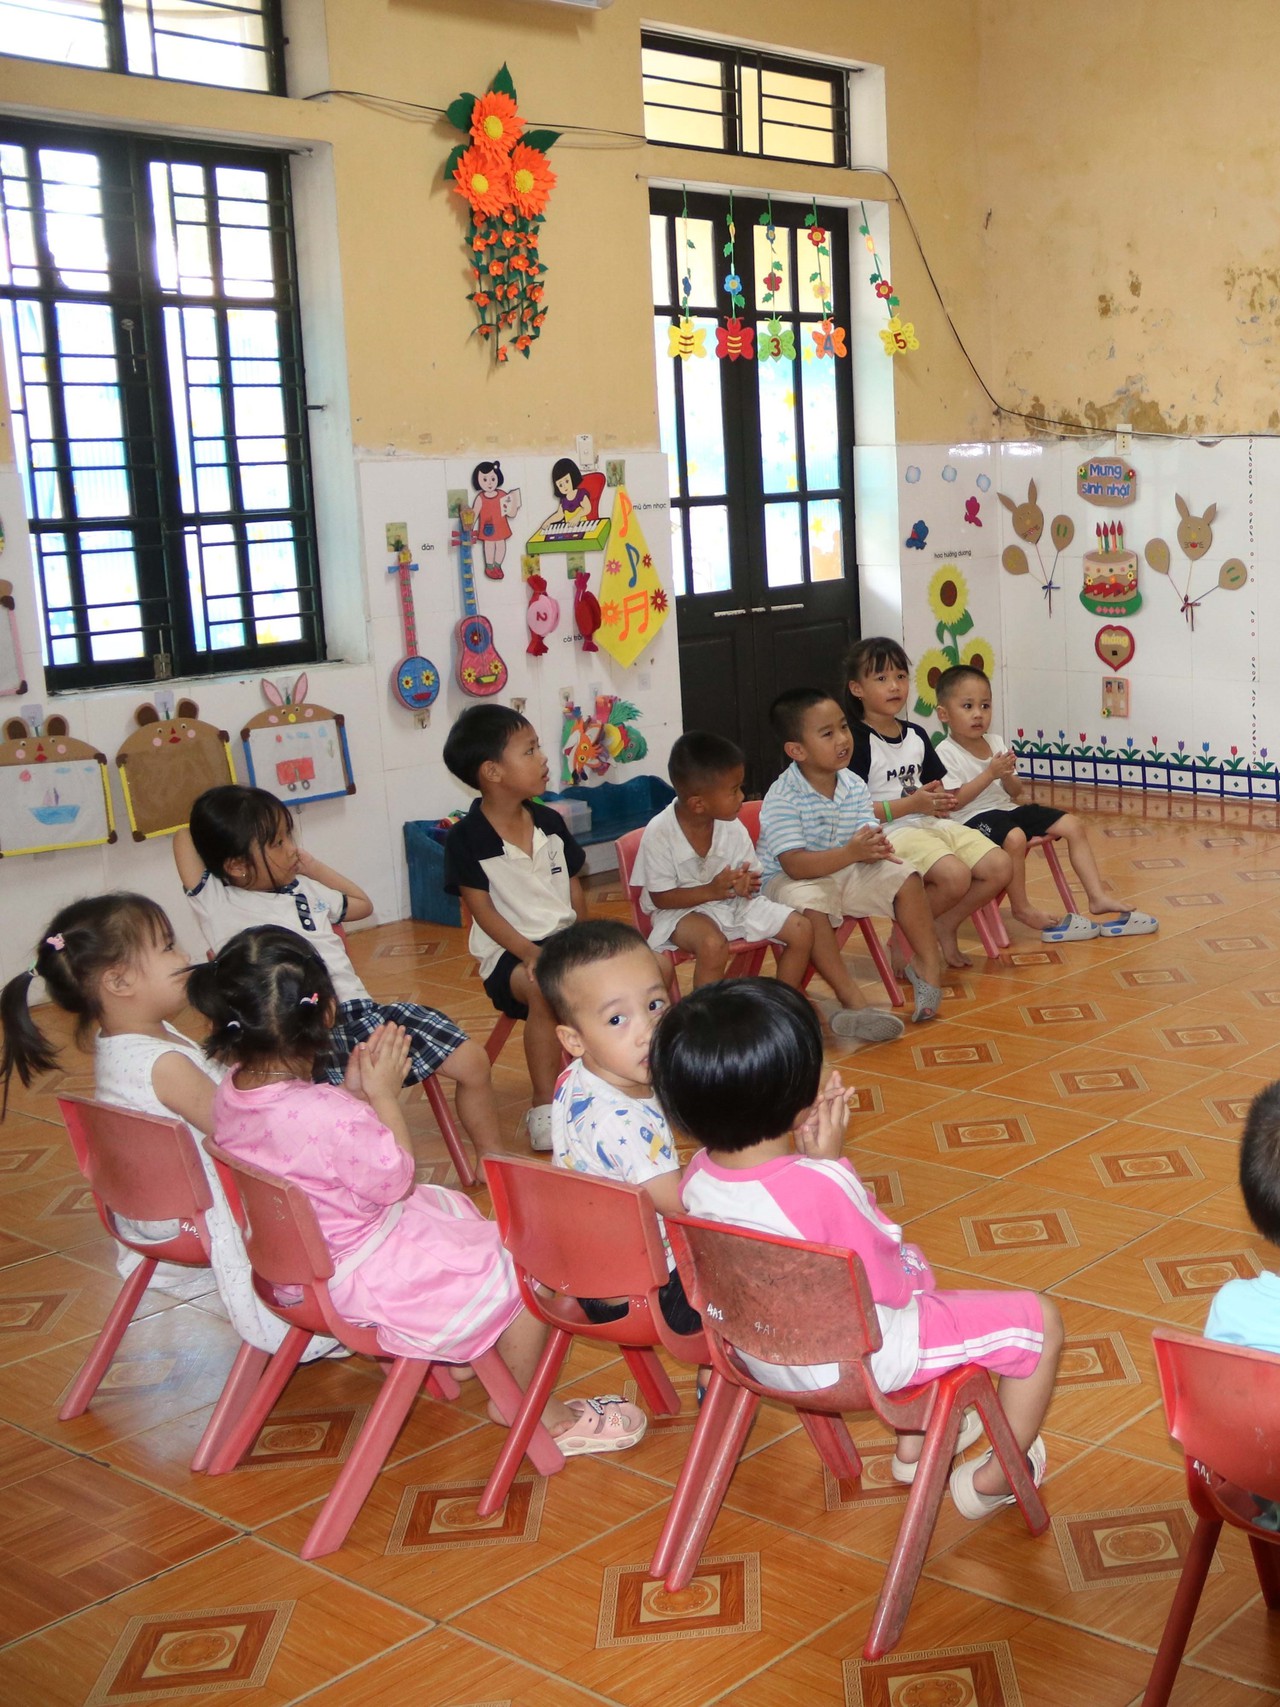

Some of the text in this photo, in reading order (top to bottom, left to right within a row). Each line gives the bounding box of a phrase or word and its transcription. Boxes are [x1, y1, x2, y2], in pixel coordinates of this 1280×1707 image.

[770, 336, 781, 356] 3
[894, 333, 907, 350] 5
[706, 1302, 724, 1321] 4A1
